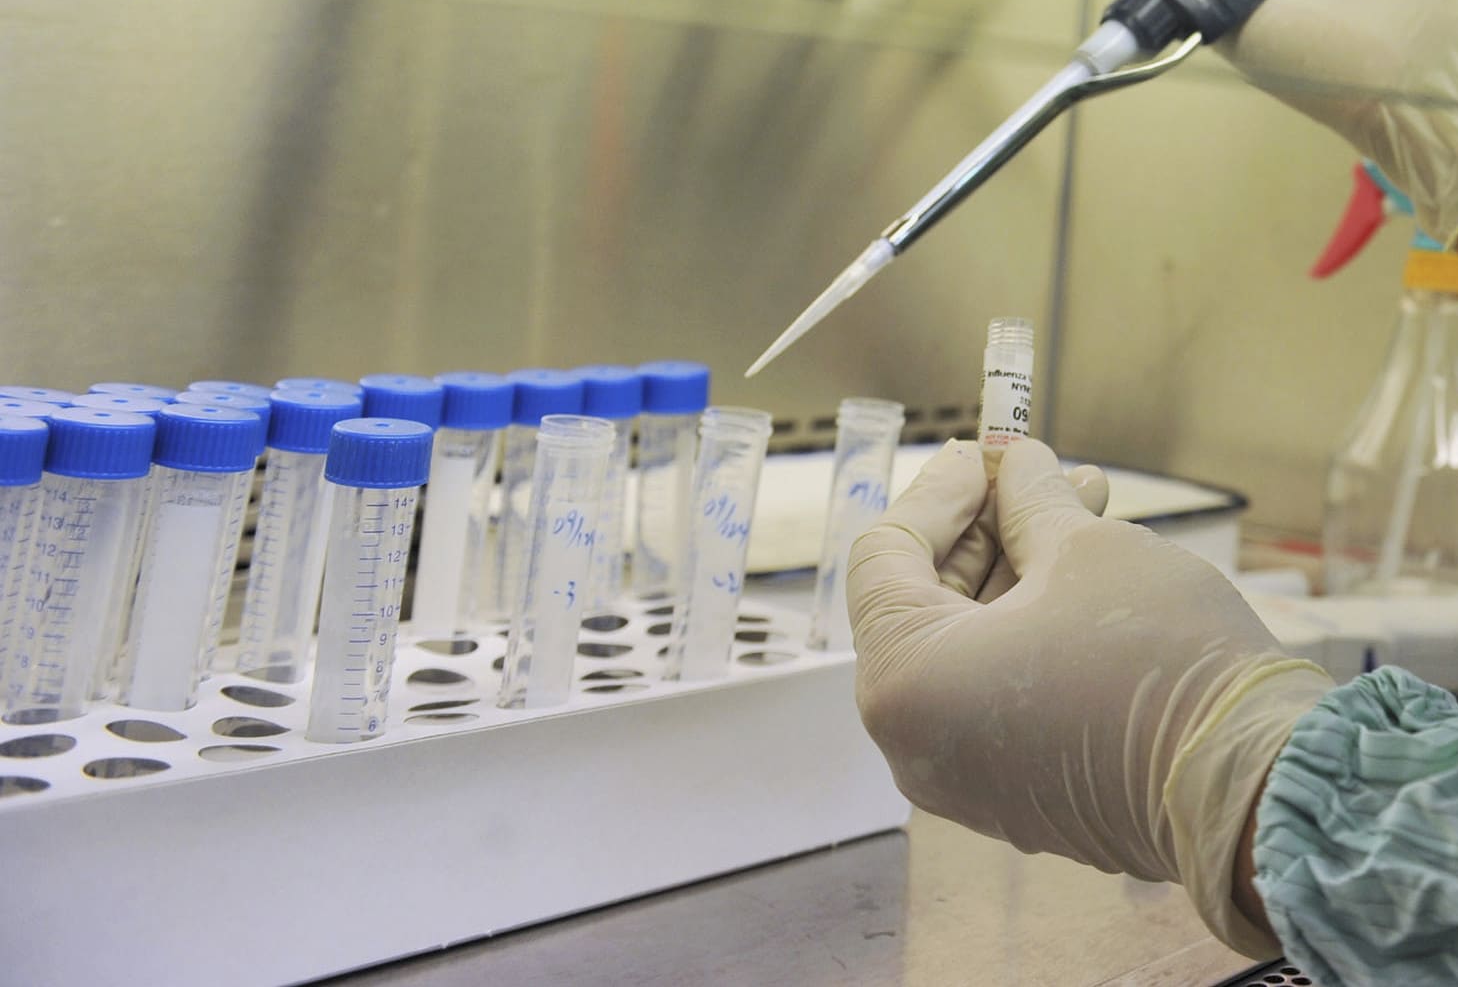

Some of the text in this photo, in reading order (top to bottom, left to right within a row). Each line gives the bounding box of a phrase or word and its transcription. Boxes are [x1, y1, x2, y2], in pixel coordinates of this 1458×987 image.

[395, 498, 407, 509] 14
[391, 523, 404, 535] 13
[388, 550, 401, 563] 12
[385, 578, 396, 589] 11
[379, 605, 394, 618] 10
[379, 633, 387, 646] 9
